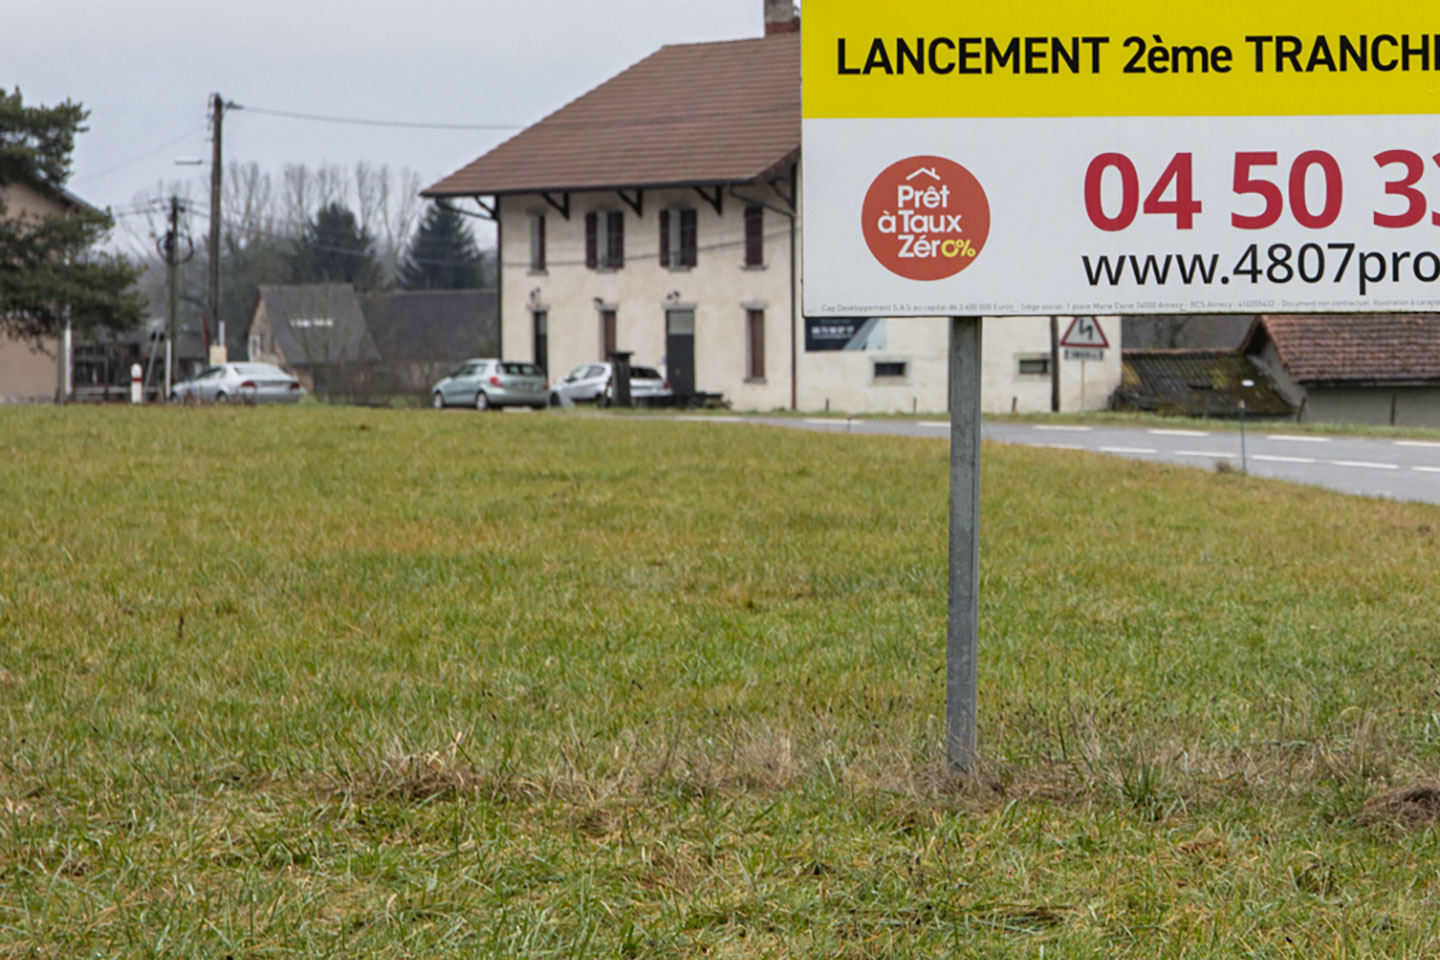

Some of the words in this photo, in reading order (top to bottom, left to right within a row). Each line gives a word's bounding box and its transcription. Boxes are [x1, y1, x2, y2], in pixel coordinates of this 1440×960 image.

[837, 36, 1110, 76] LANCEMENT
[1122, 34, 1233, 74] 2ème
[897, 184, 950, 209] Prêt
[1084, 152, 1202, 232] 04
[1231, 149, 1343, 230] 50
[877, 209, 896, 234] à
[897, 209, 962, 233] Taux
